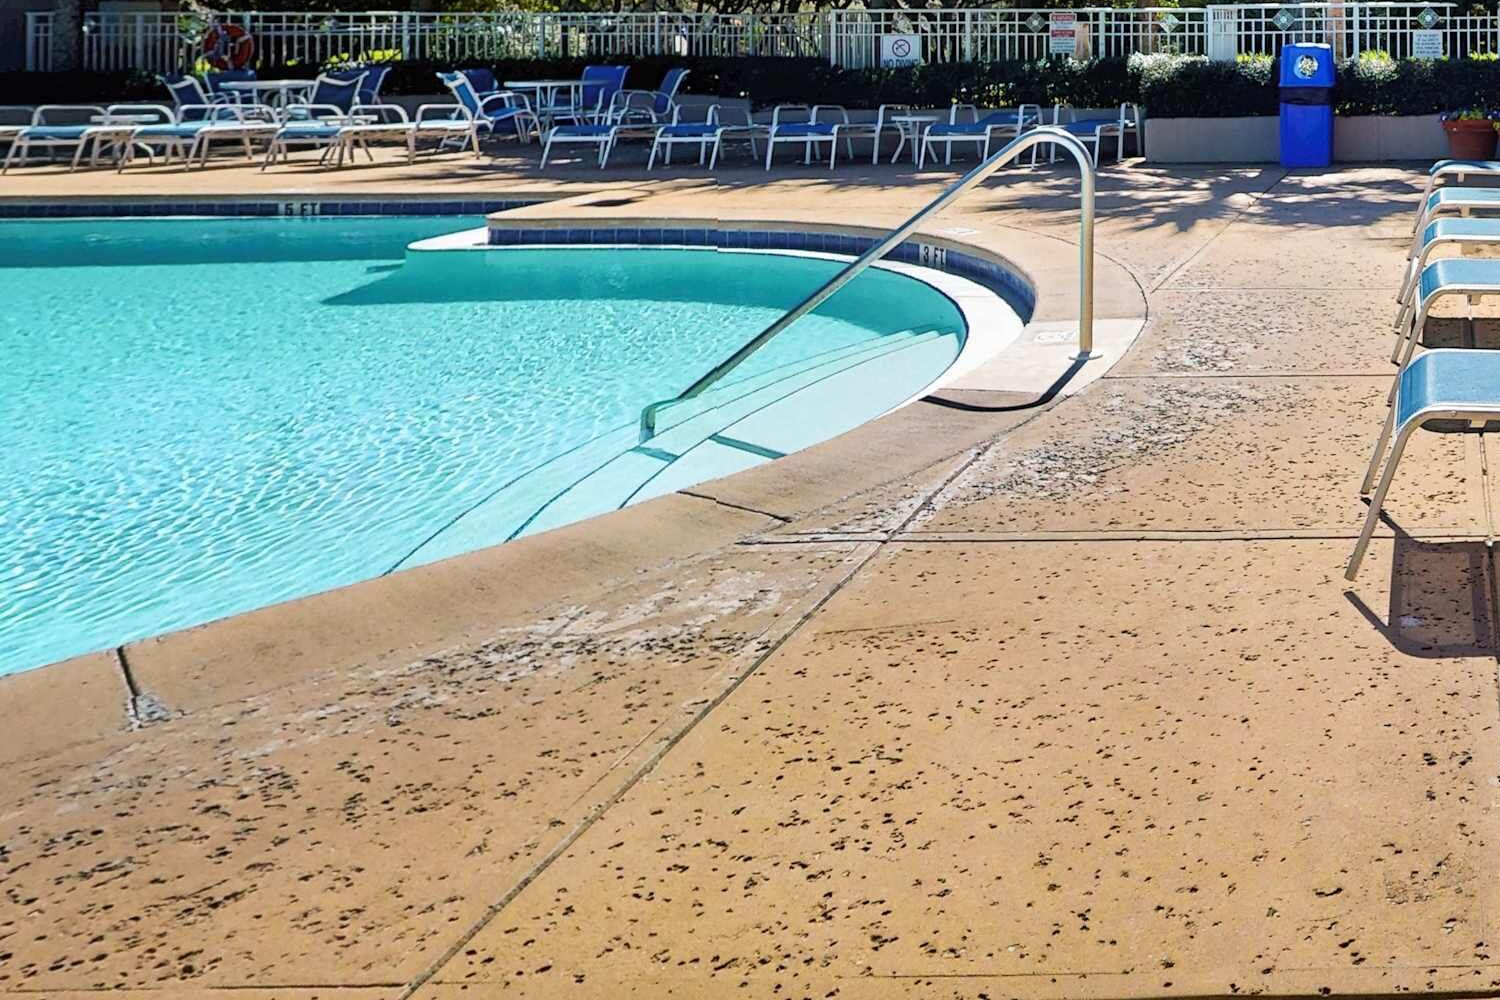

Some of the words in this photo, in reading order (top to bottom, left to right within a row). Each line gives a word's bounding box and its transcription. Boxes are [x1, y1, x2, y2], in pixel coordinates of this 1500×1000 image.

[300, 202, 318, 216] FT
[923, 246, 929, 263] 3
[934, 247, 944, 265] FT
